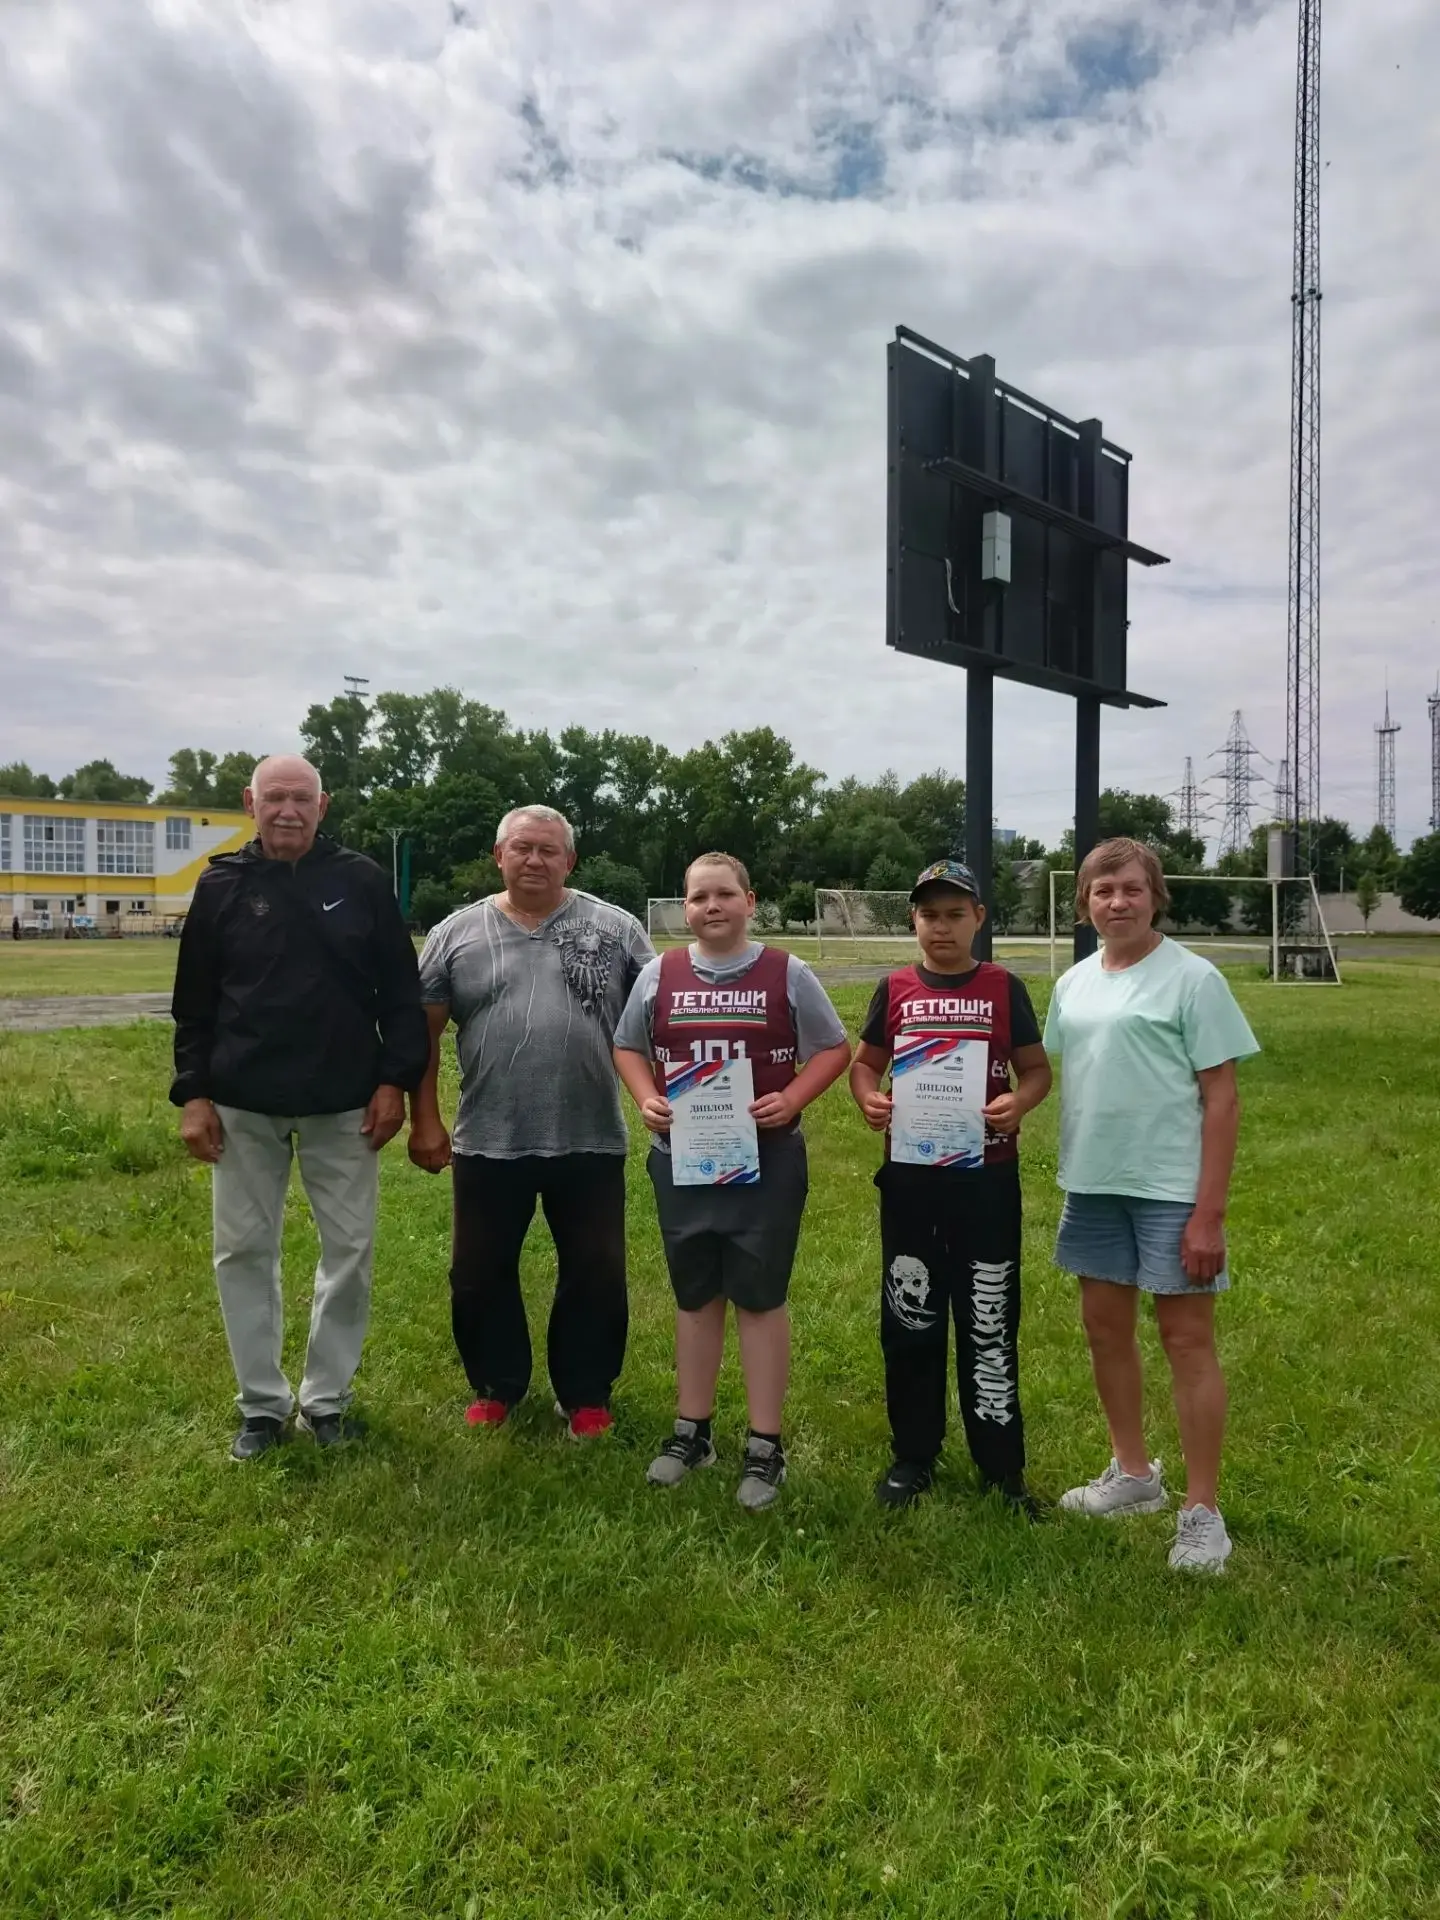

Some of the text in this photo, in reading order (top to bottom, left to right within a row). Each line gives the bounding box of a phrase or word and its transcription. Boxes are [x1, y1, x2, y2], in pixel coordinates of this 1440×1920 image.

[671, 990, 767, 1008] ТЕТЮШИ
[670, 1006, 767, 1016] РЕСПУБЛИКА ТАТАРСТАН
[900, 998, 993, 1018] ТЕТЮШИ
[900, 1015, 993, 1026] РЕСПУБЛИКА ТАТАРСТАН
[689, 1039, 747, 1062] 101
[915, 1083, 963, 1094] ДИПЛОМ
[689, 1103, 734, 1113] ДИПЛОМ
